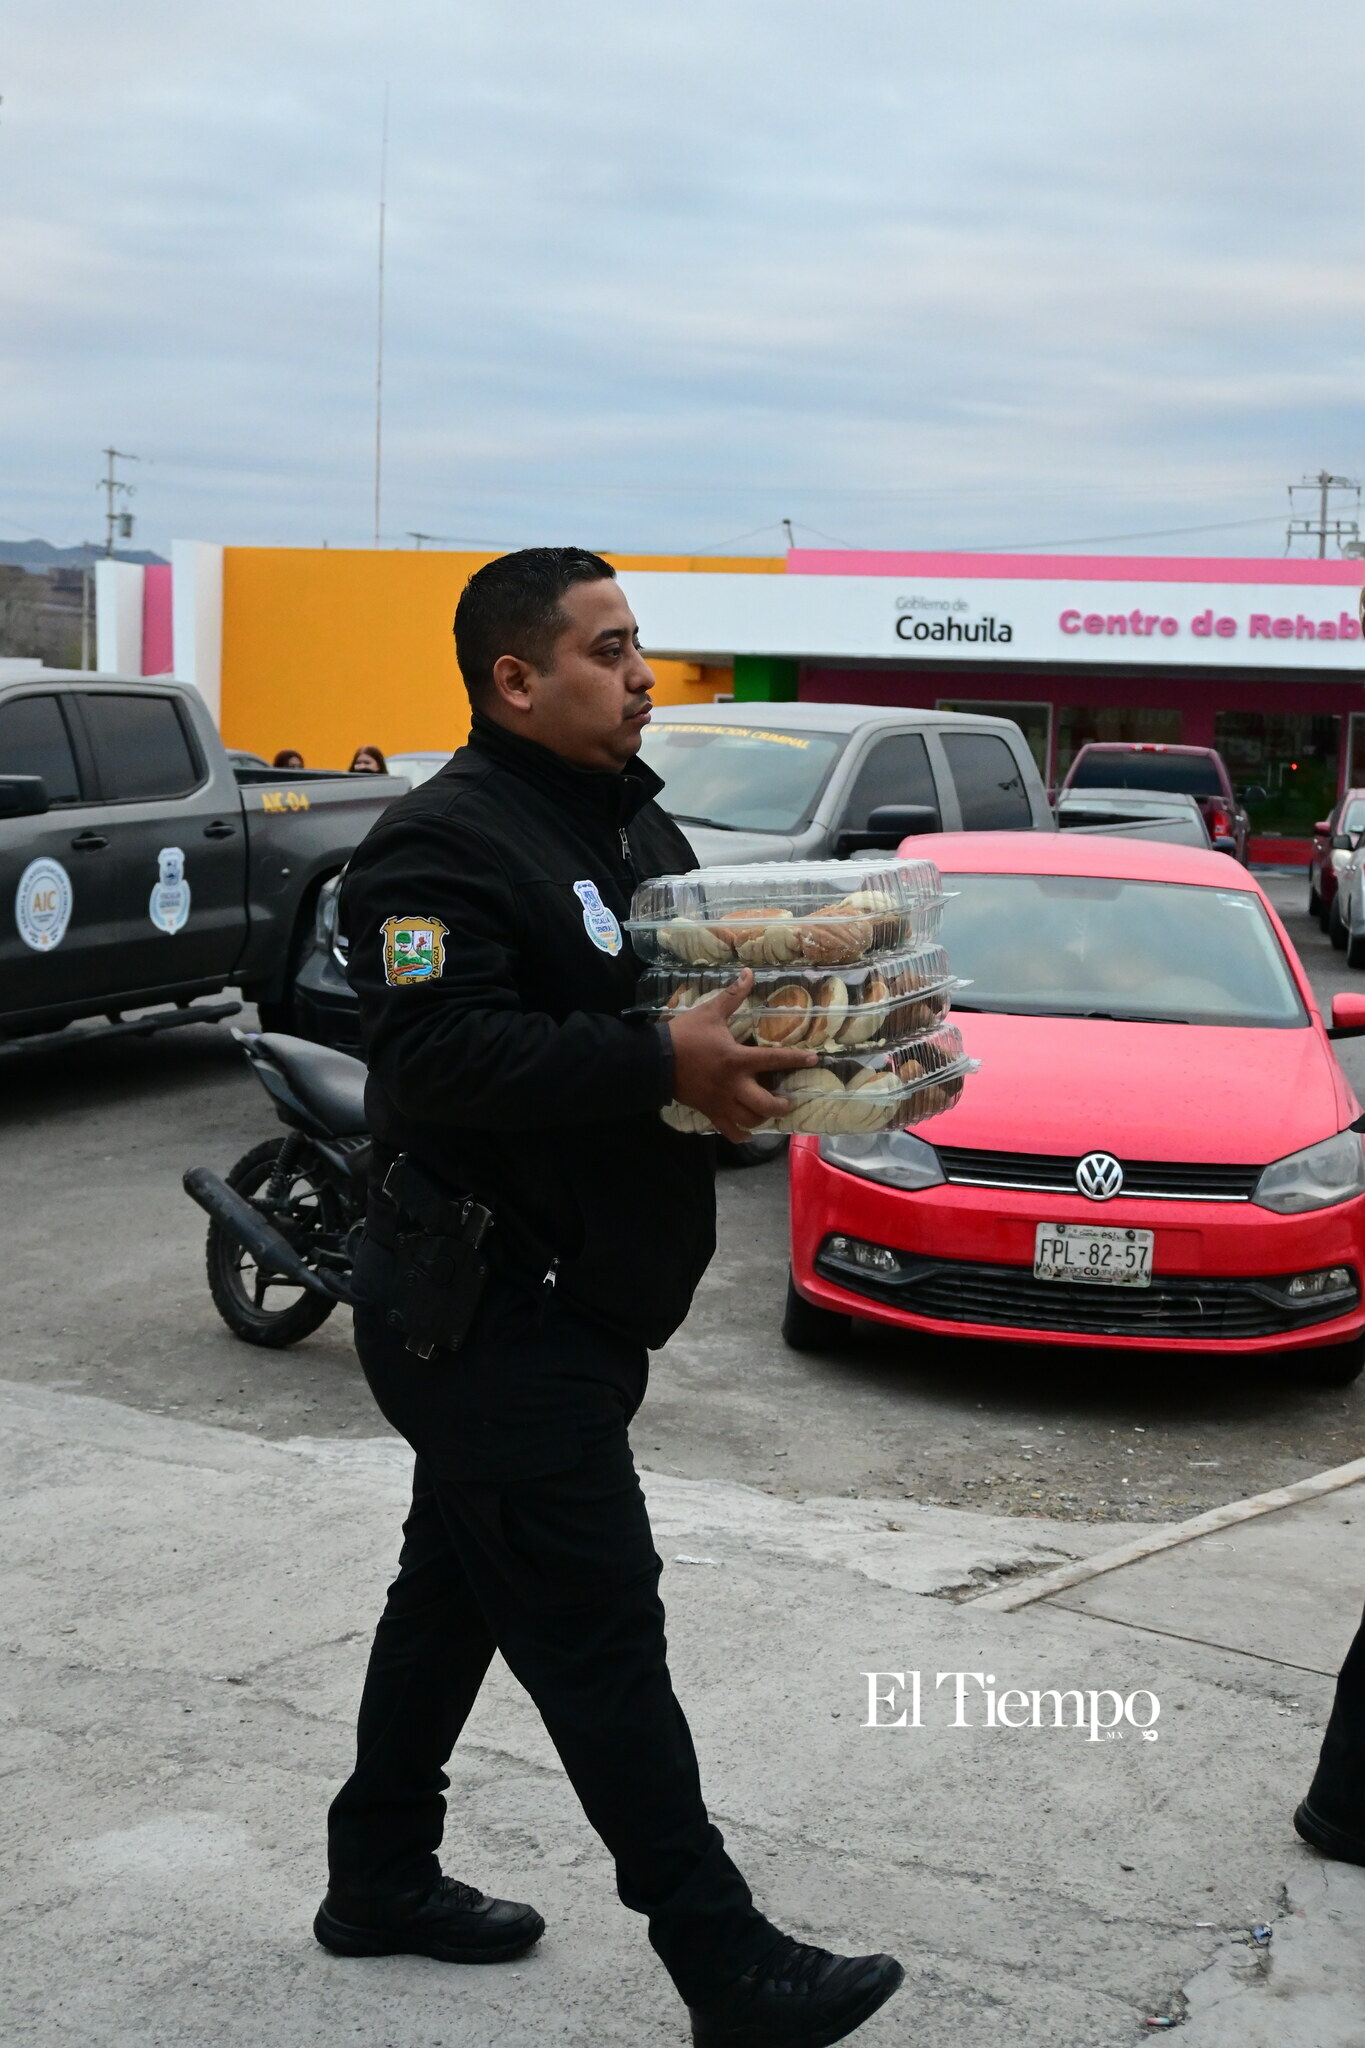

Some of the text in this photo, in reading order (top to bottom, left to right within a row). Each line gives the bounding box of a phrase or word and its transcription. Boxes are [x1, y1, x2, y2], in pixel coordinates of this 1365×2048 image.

[895, 597, 969, 612] Gobierno de
[896, 616, 1014, 643] Coahuila
[1059, 609, 1361, 640] Centro de Rehab
[33, 890, 57, 913] AIC
[423, 946, 440, 981] RAGOZA
[1040, 1239, 1149, 1270] FPL-82-57
